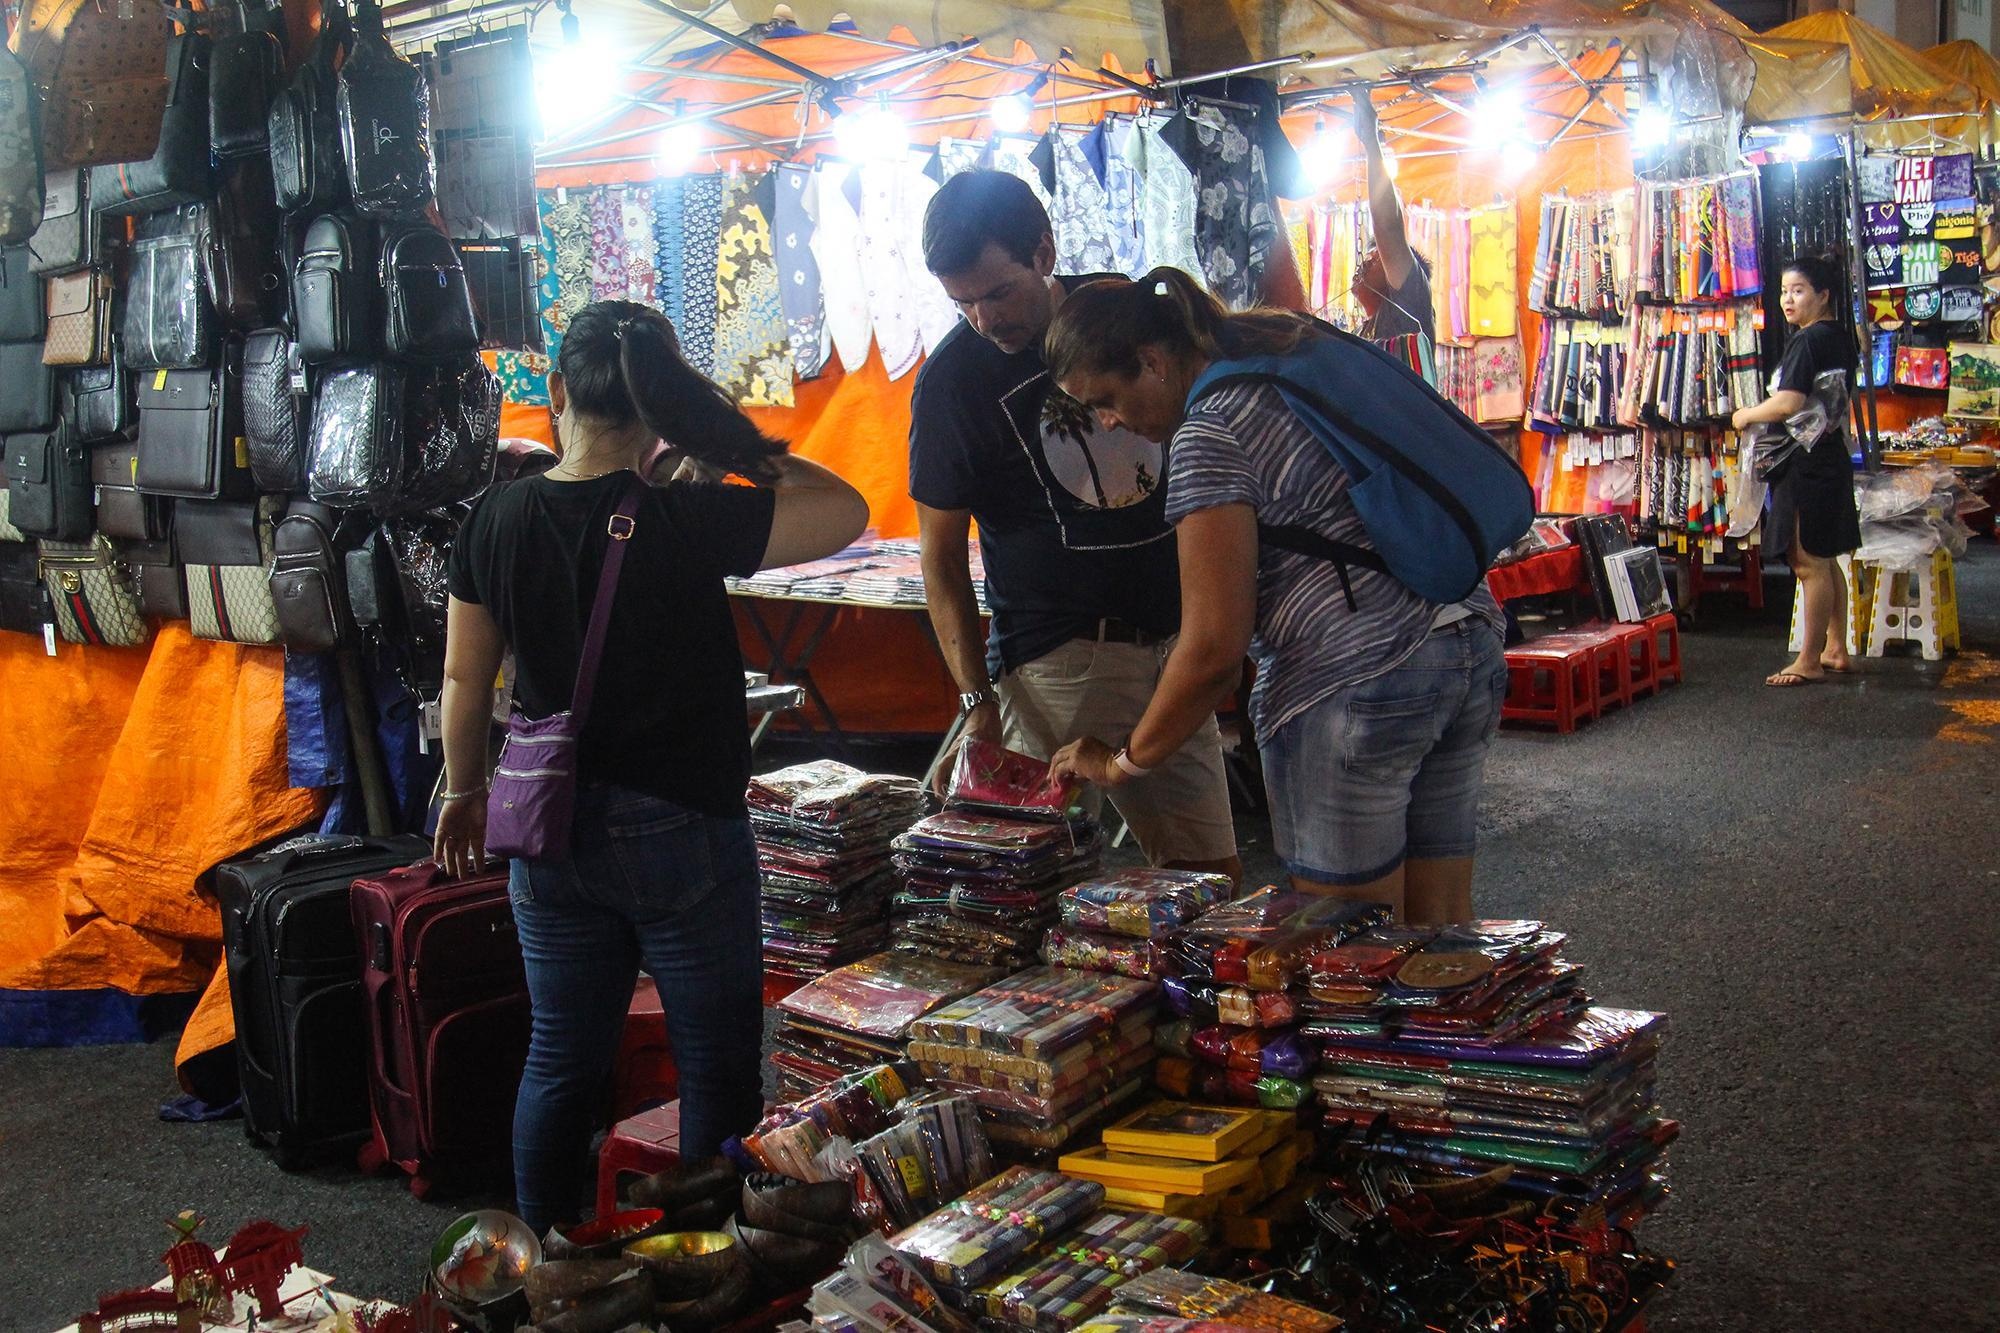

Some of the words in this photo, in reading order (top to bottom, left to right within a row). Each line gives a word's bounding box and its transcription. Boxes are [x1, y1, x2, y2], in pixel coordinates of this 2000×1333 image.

[1895, 157, 1933, 180] VIET
[1865, 205, 1874, 223] I
[1954, 251, 1980, 267] Tige
